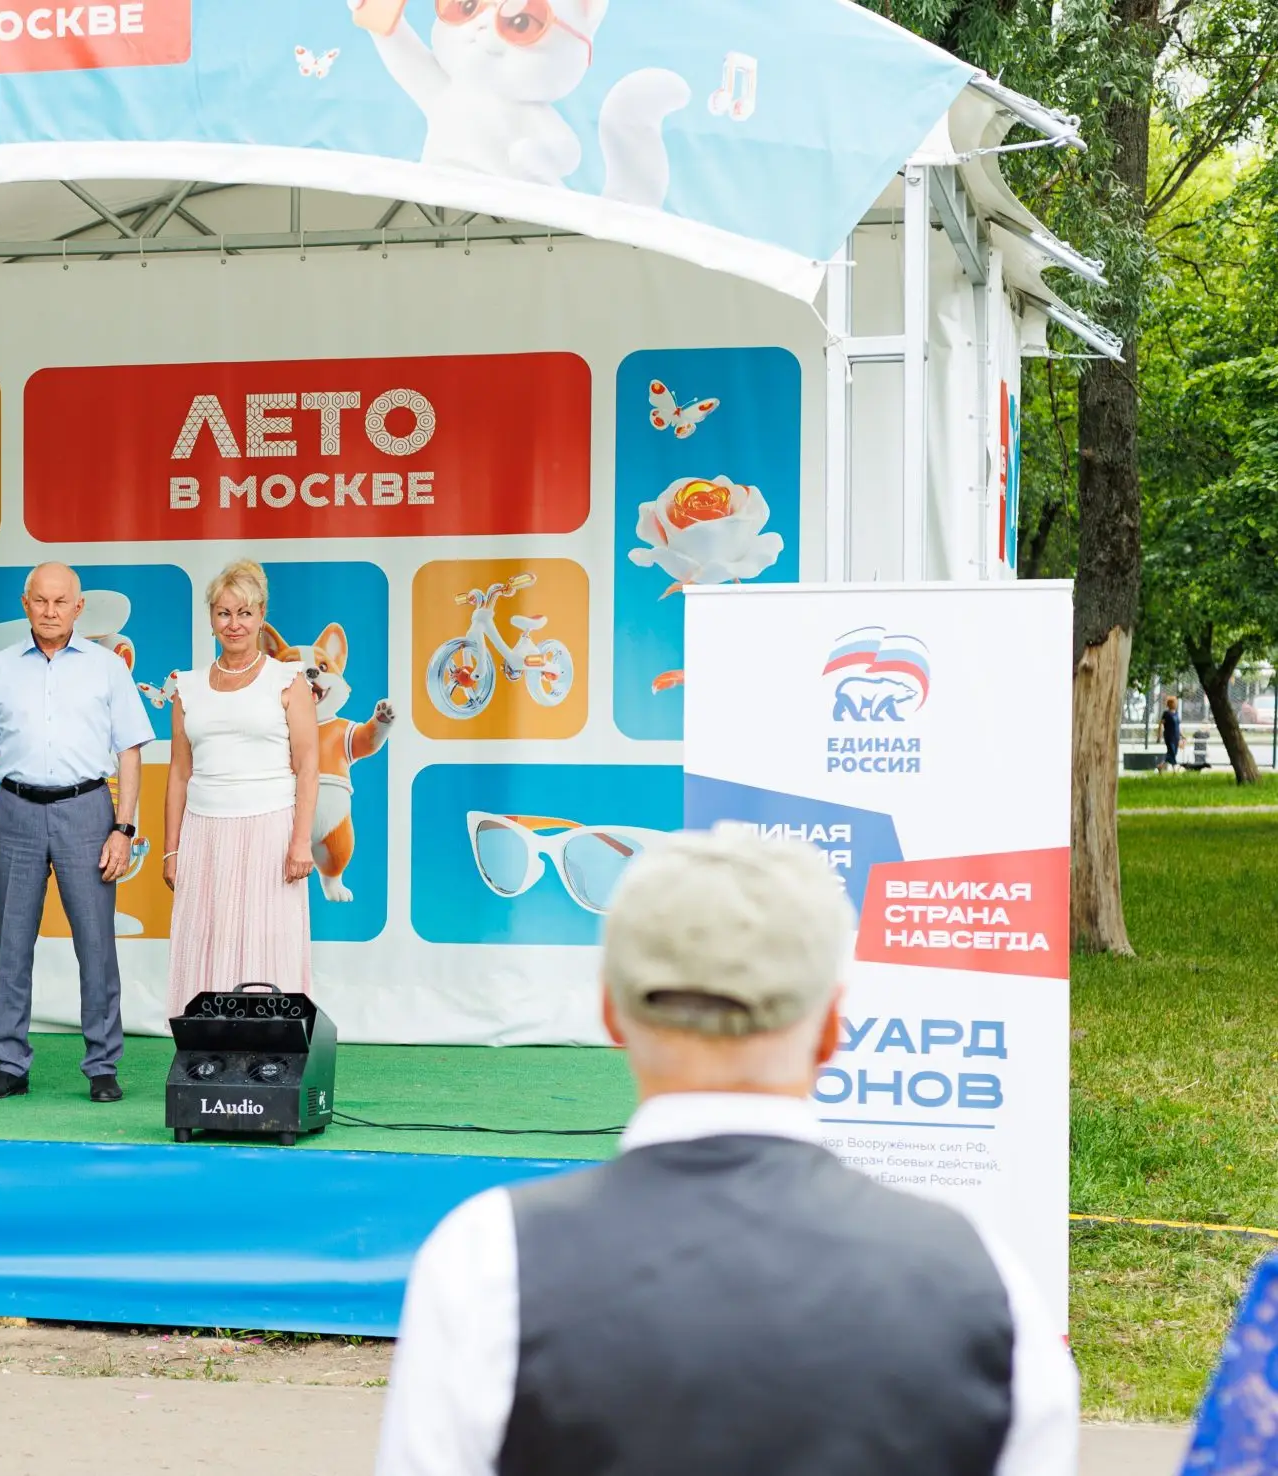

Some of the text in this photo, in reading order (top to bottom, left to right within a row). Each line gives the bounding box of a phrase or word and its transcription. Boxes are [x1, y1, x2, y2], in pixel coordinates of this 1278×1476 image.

[170, 388, 436, 459] ЛЕТО
[170, 472, 435, 509] В МОСКВЕ
[827, 737, 921, 754] ЕДИНАЯ
[827, 757, 921, 773] РОССИЯ
[885, 880, 1032, 902] ВЕЛИКАЯ
[885, 905, 1010, 926] СТРАНА
[885, 929, 1050, 952] НАВСЕГДА
[837, 1017, 1007, 1059] УАРД
[812, 1066, 1004, 1110] ОНОВ
[200, 1098, 264, 1115] LAudio
[847, 1136, 935, 1152] Вооружённых
[939, 1141, 962, 1153] сил
[839, 1156, 884, 1168] етеран
[887, 1155, 934, 1168] боевых
[930, 1174, 983, 1187] Россия»
